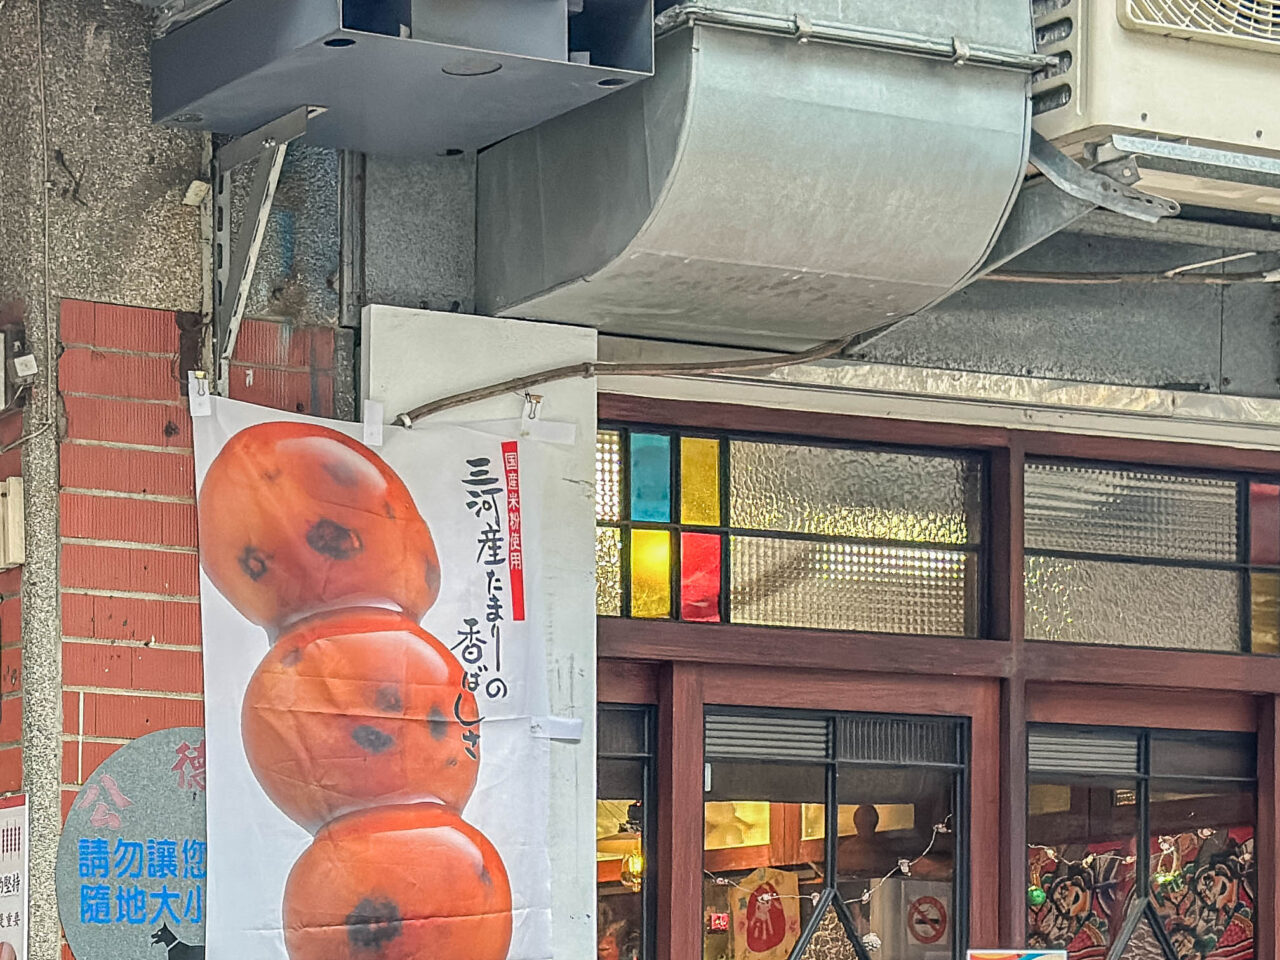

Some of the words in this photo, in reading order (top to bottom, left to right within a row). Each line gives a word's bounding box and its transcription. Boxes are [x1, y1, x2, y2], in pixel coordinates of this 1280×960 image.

[505, 452, 522, 570] 国産米粉使用
[78, 837, 206, 879] 請勿讓您
